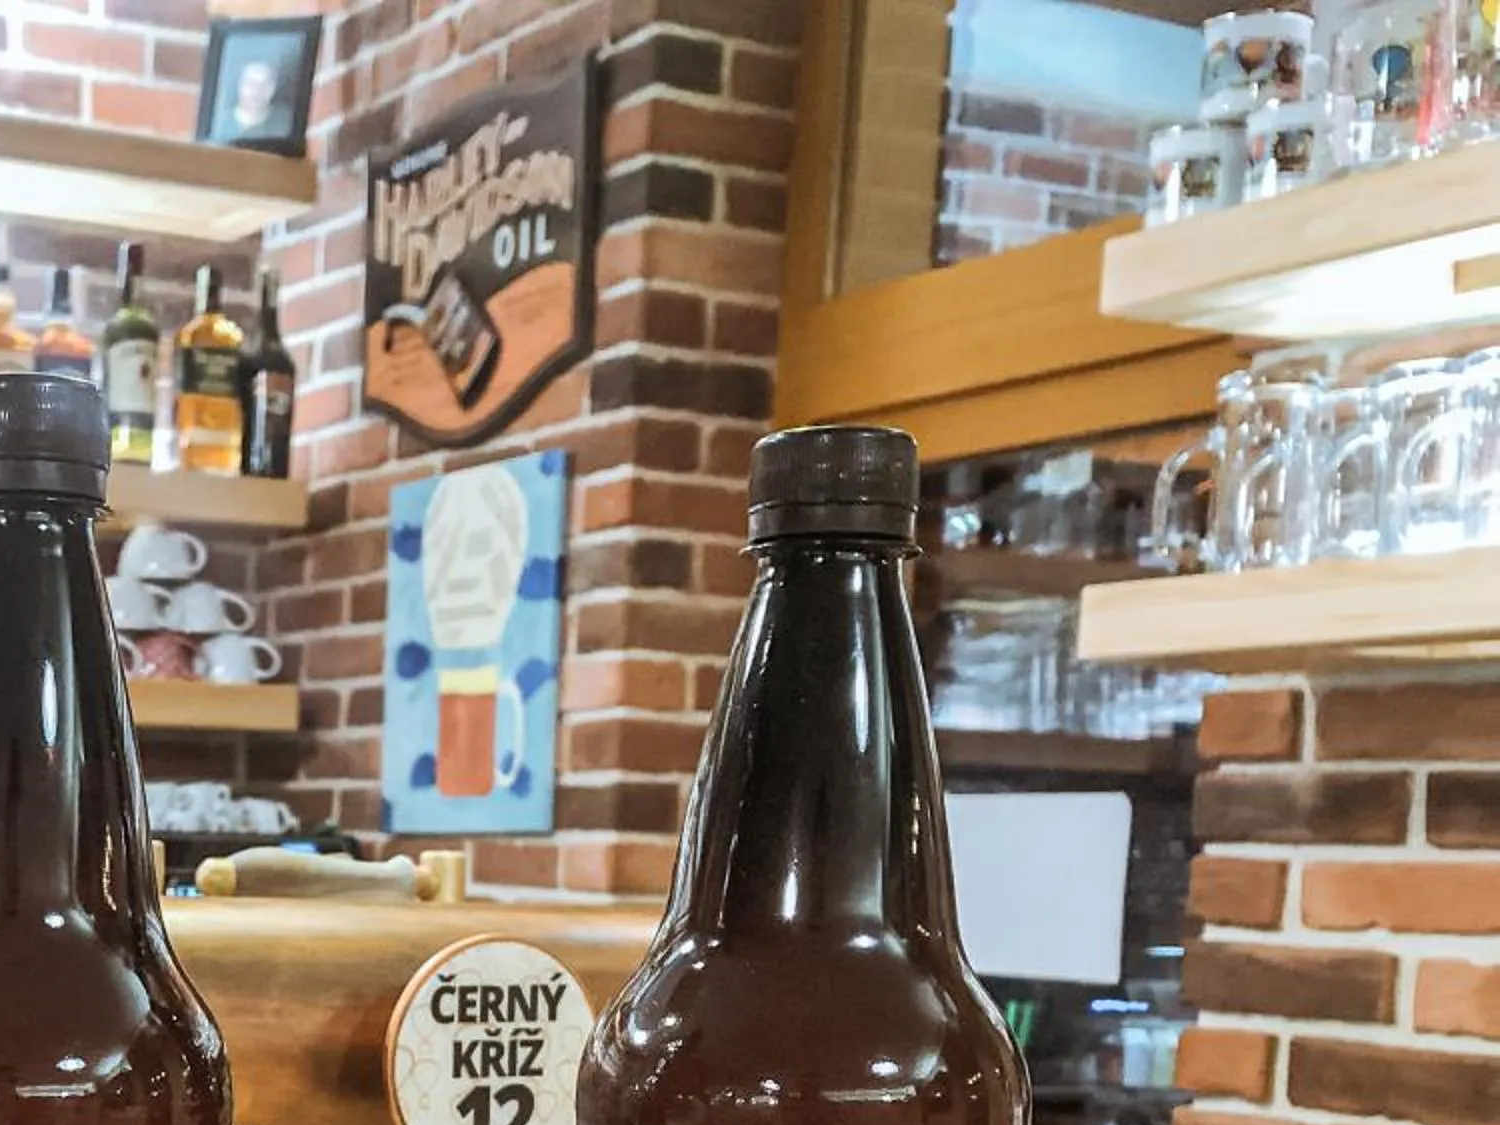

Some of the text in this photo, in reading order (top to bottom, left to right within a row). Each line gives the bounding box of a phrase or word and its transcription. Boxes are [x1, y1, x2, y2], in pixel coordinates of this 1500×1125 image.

[493, 214, 555, 269] OIL
[430, 972, 567, 1024] ČERNÝ
[452, 1028, 544, 1079] KŘÍŽ
